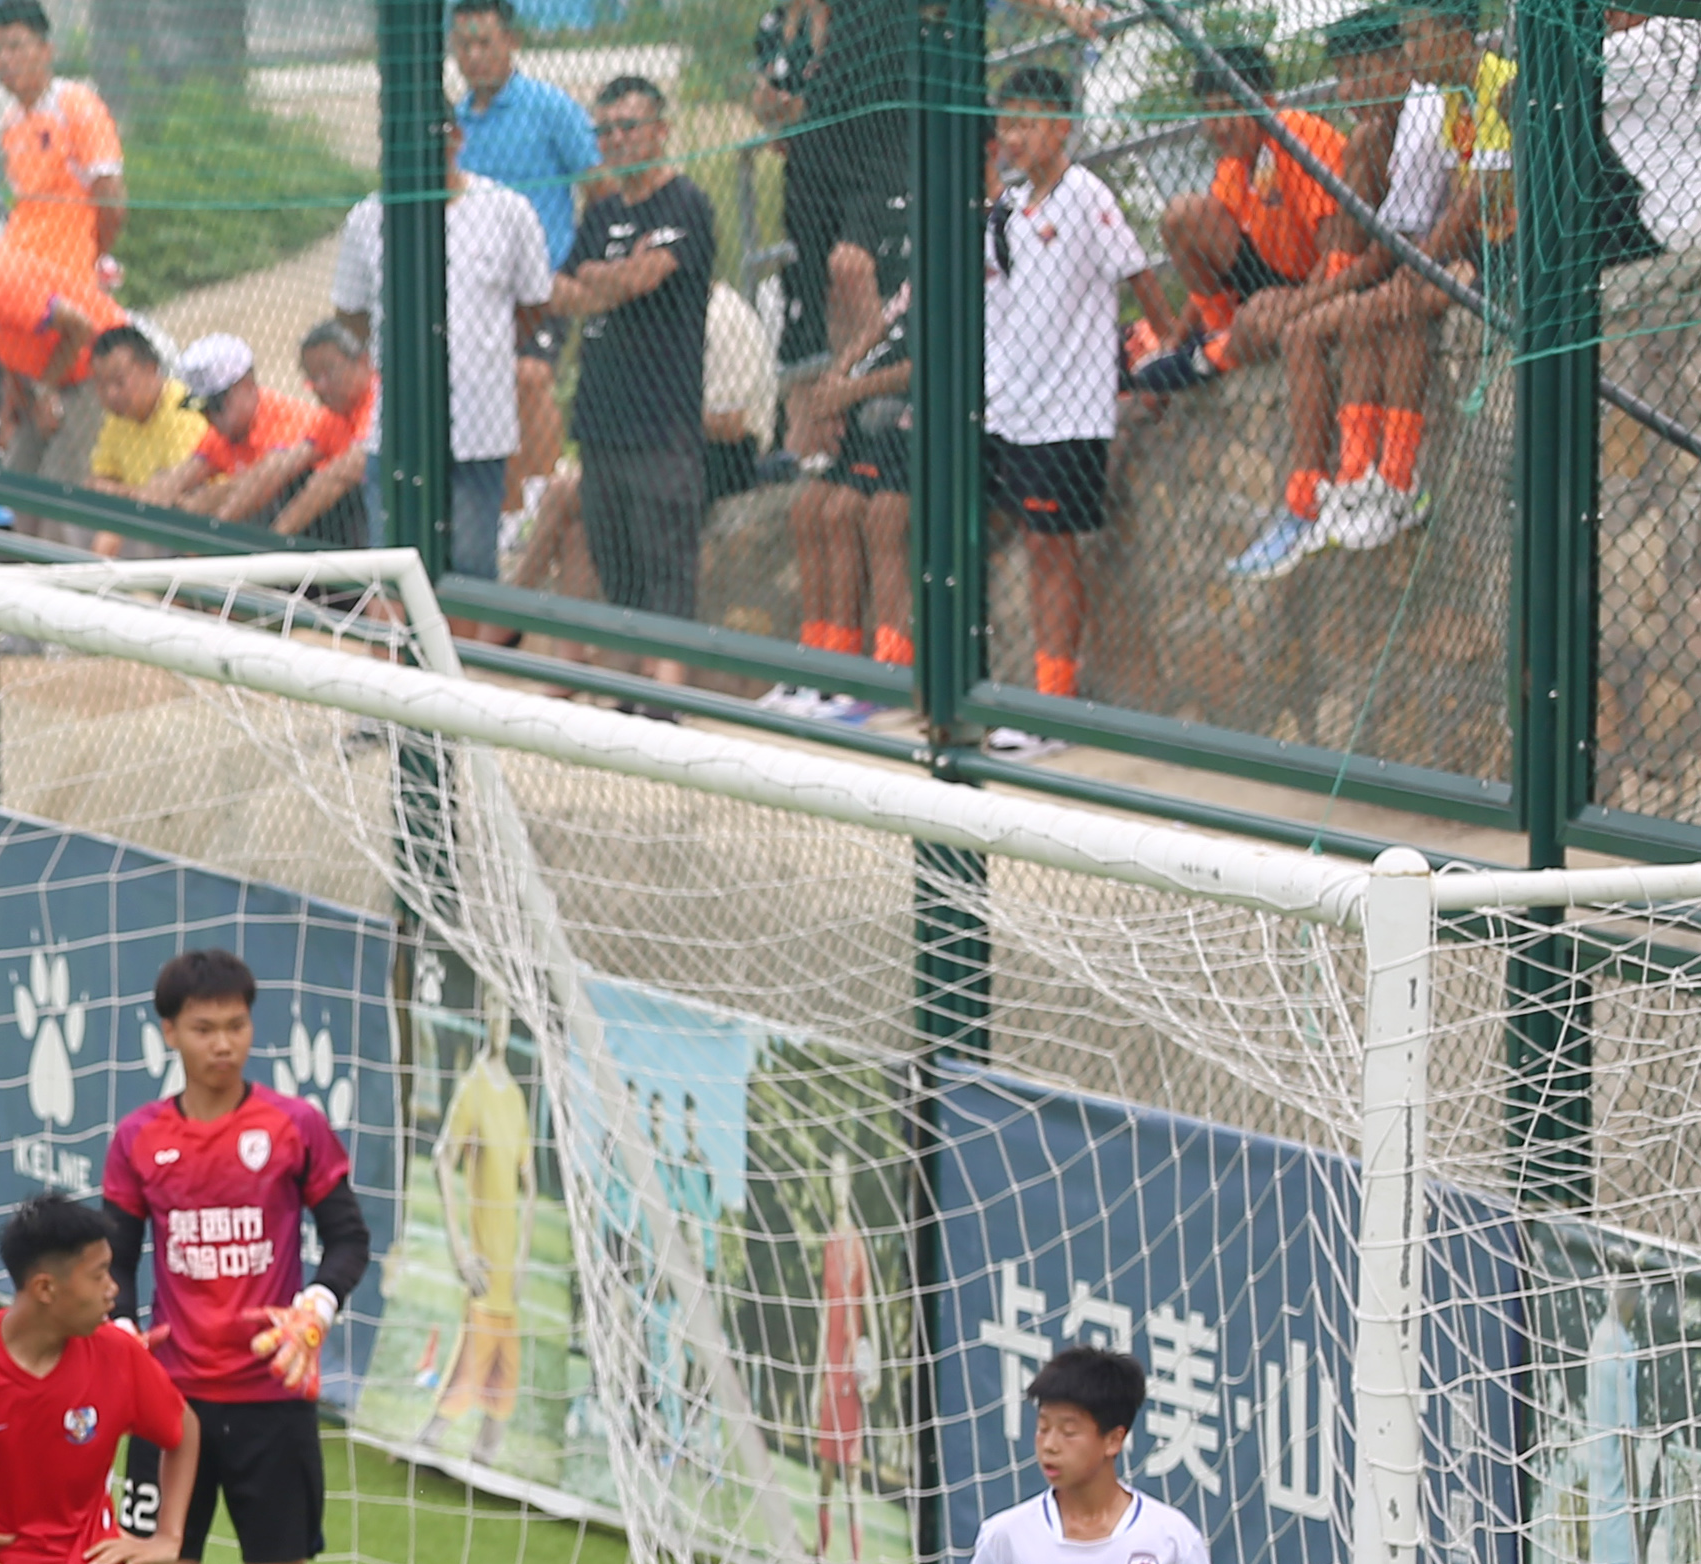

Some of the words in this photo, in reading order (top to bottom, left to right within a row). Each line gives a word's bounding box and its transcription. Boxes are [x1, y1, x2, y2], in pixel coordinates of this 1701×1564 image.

[13, 1135, 92, 1193] KELME
[168, 1206, 263, 1244] 莱西市
[980, 1258, 1429, 1521] 卡美·山
